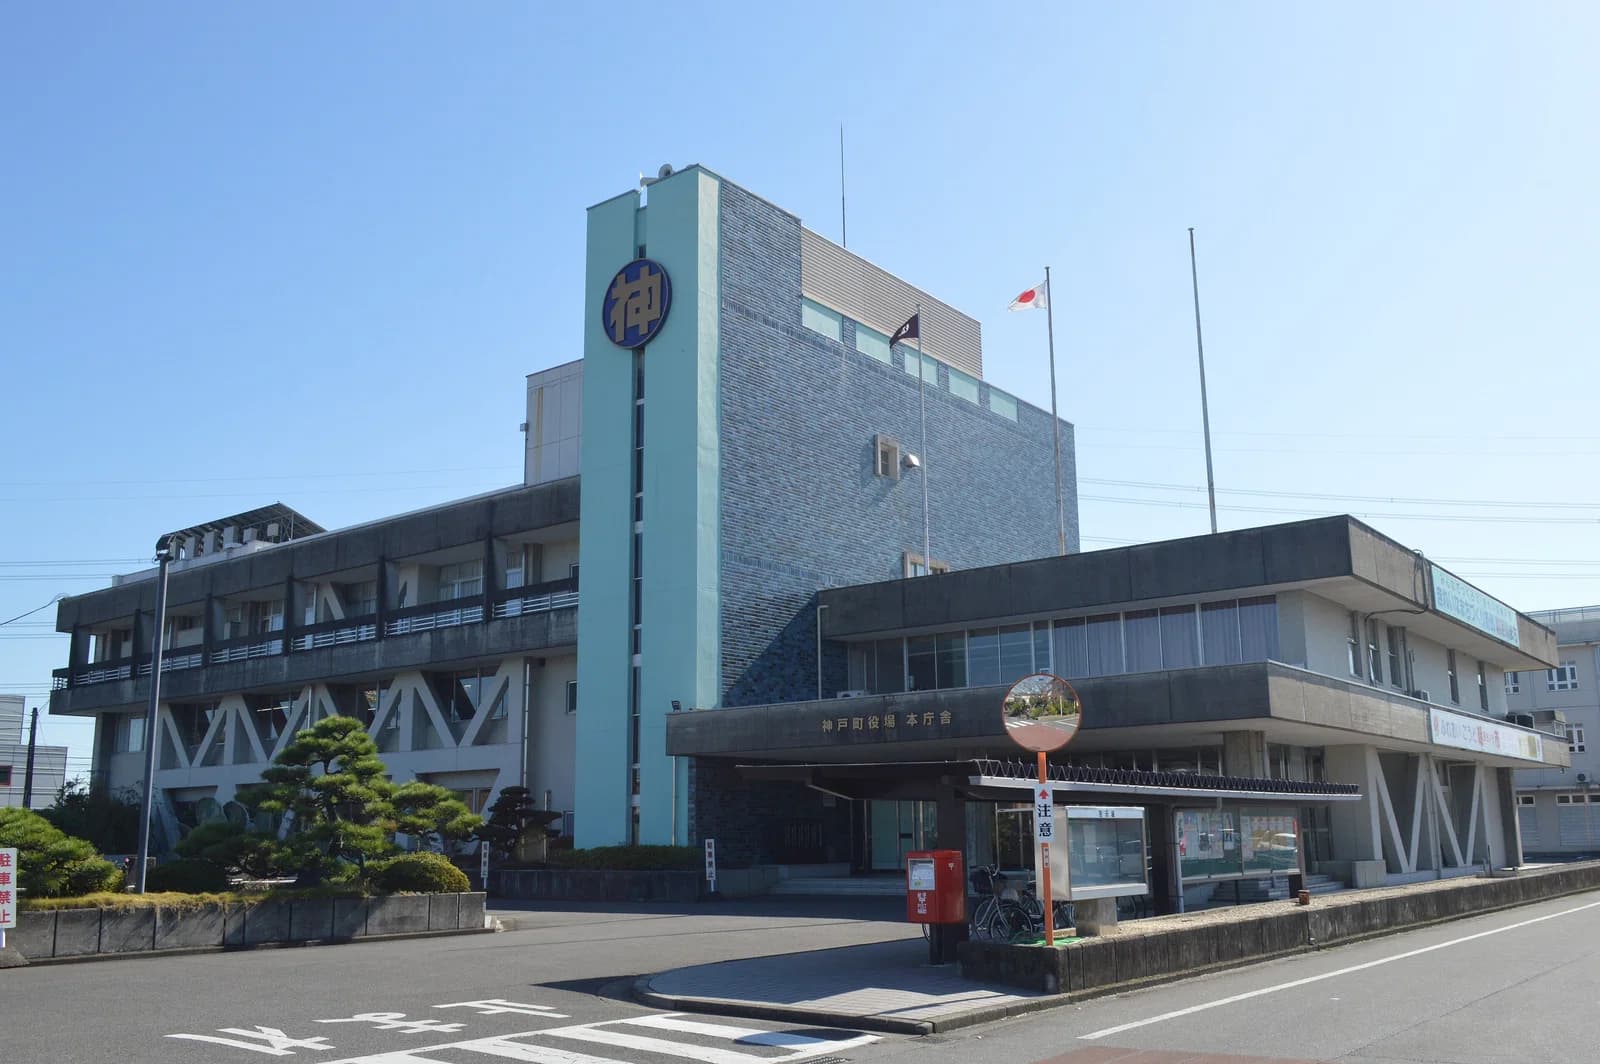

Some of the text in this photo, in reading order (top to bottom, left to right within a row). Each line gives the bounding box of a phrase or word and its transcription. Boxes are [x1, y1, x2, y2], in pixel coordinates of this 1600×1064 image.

[610, 265, 661, 342] 神
[822, 710, 952, 733] 神戸町役場 本庁舎
[1038, 803, 1052, 837] 注意
[0, 853, 12, 923] 駐車禁止
